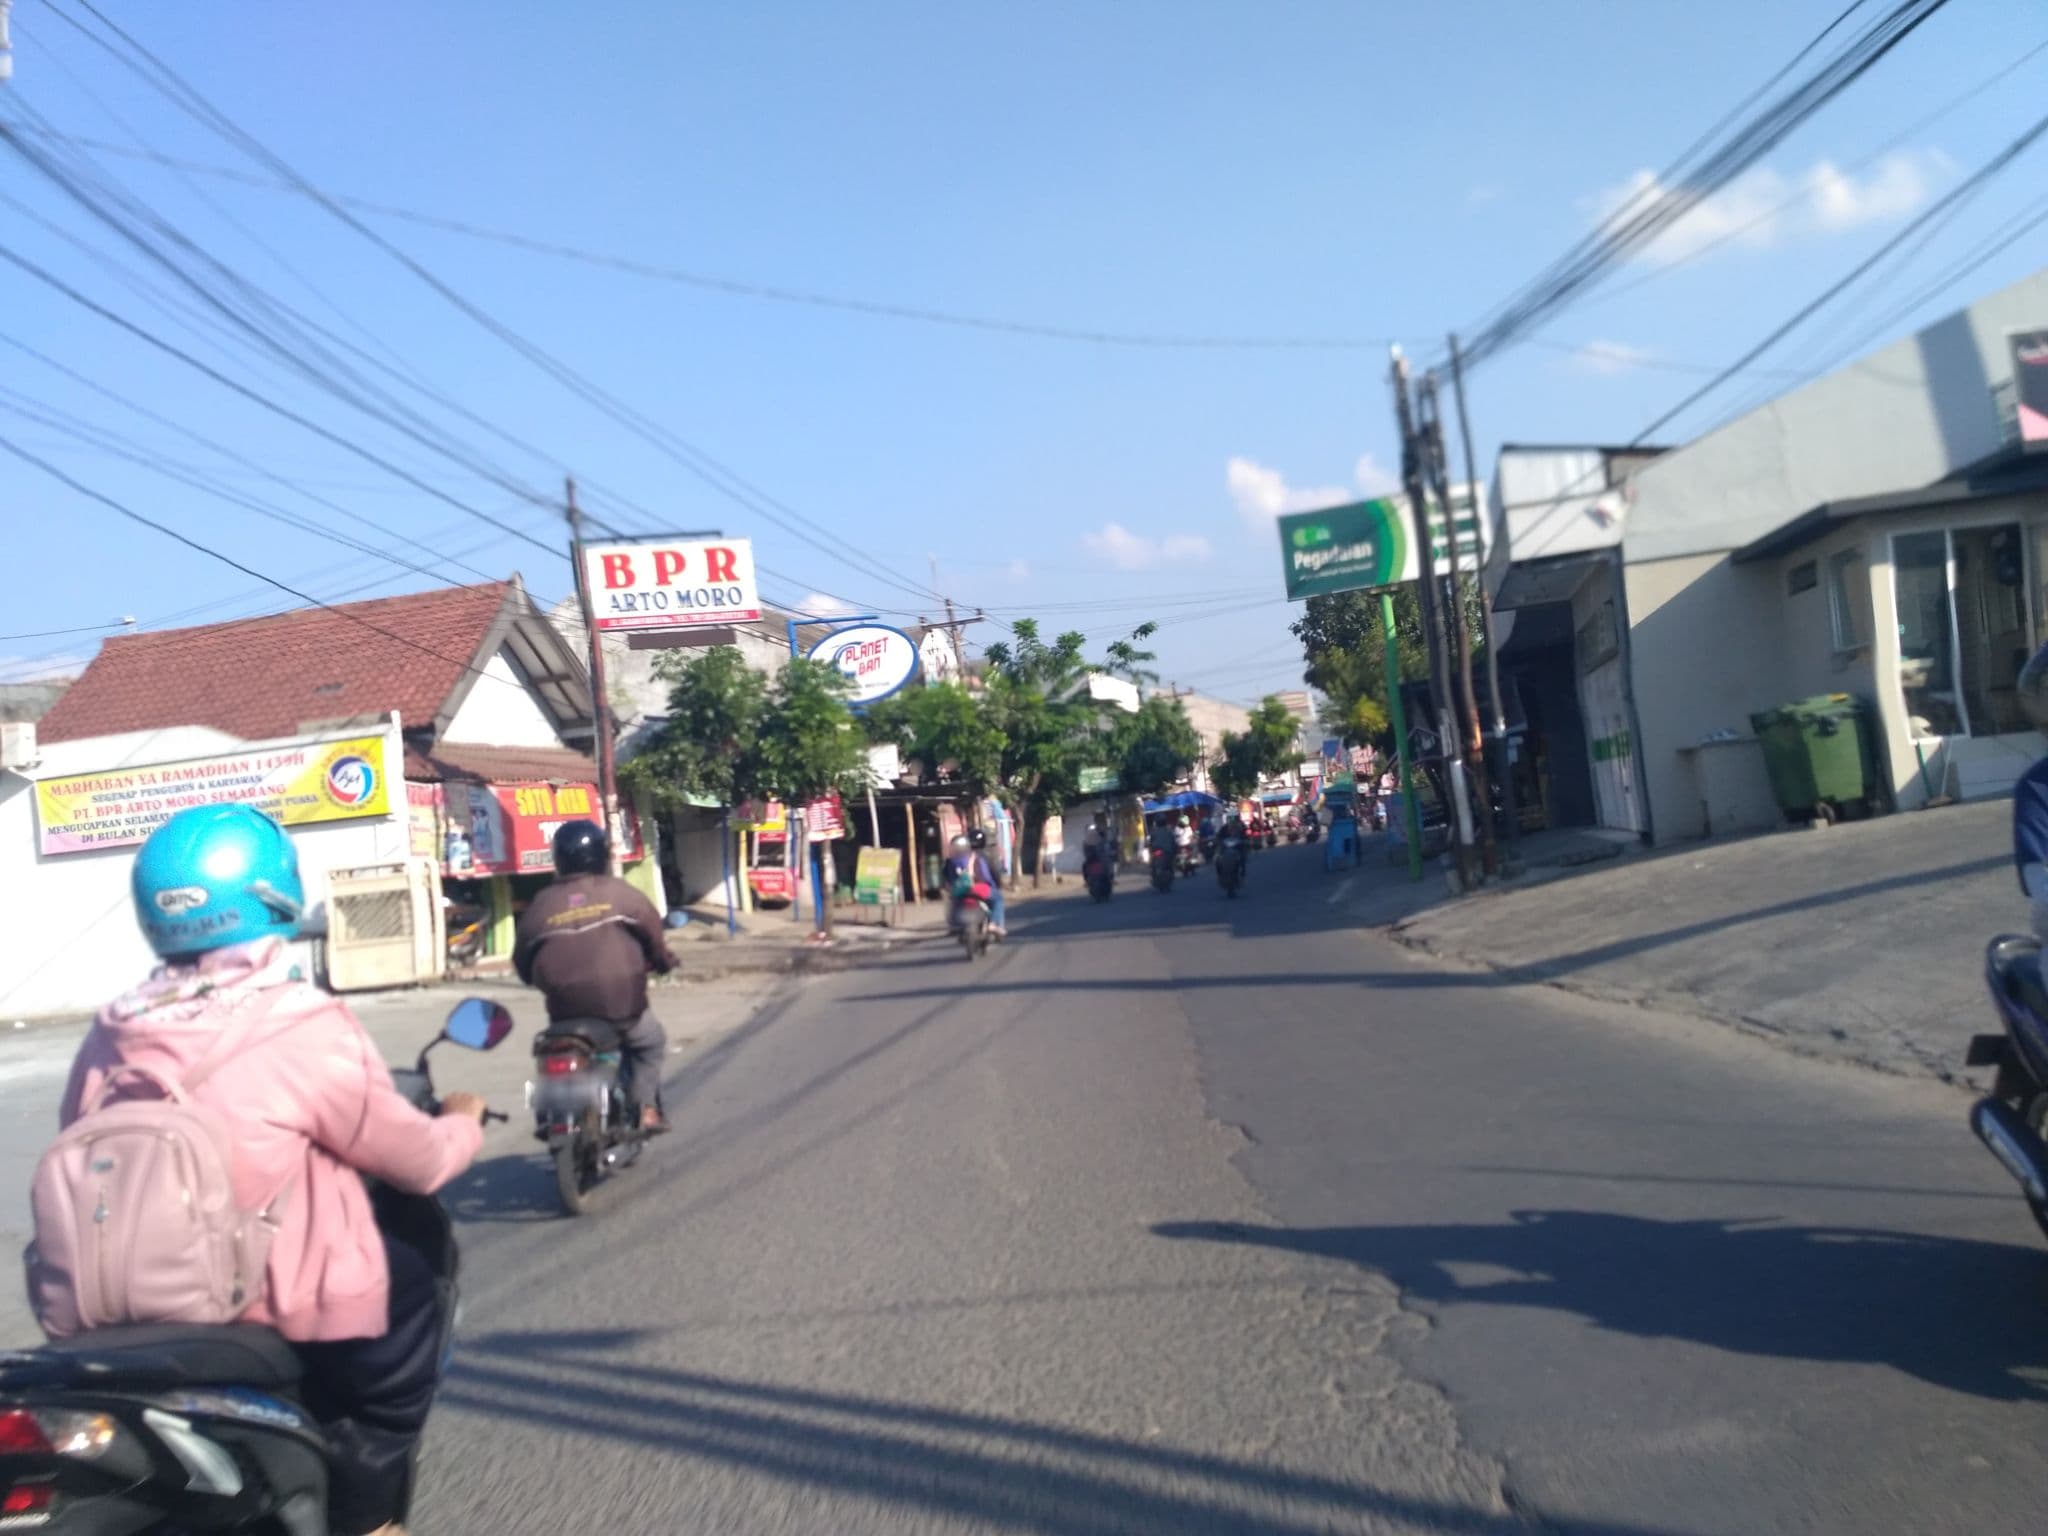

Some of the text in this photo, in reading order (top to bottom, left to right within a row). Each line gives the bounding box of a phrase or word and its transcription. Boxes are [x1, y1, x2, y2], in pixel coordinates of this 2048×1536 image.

[610, 586, 743, 612] ARTO MORO
[845, 636, 889, 664] PLANET
[858, 656, 881, 676] BAN
[51, 777, 134, 796] MARHABAN
[138, 773, 157, 787] YA
[161, 761, 250, 783] RAMADHAN
[96, 804, 122, 818] BPR
[125, 800, 162, 815] ARTO
[166, 793, 207, 808] MORO
[211, 783, 287, 802] SEMARANG
[48, 818, 122, 835] MENGUCAPKAN
[98, 829, 136, 842] BULAN
